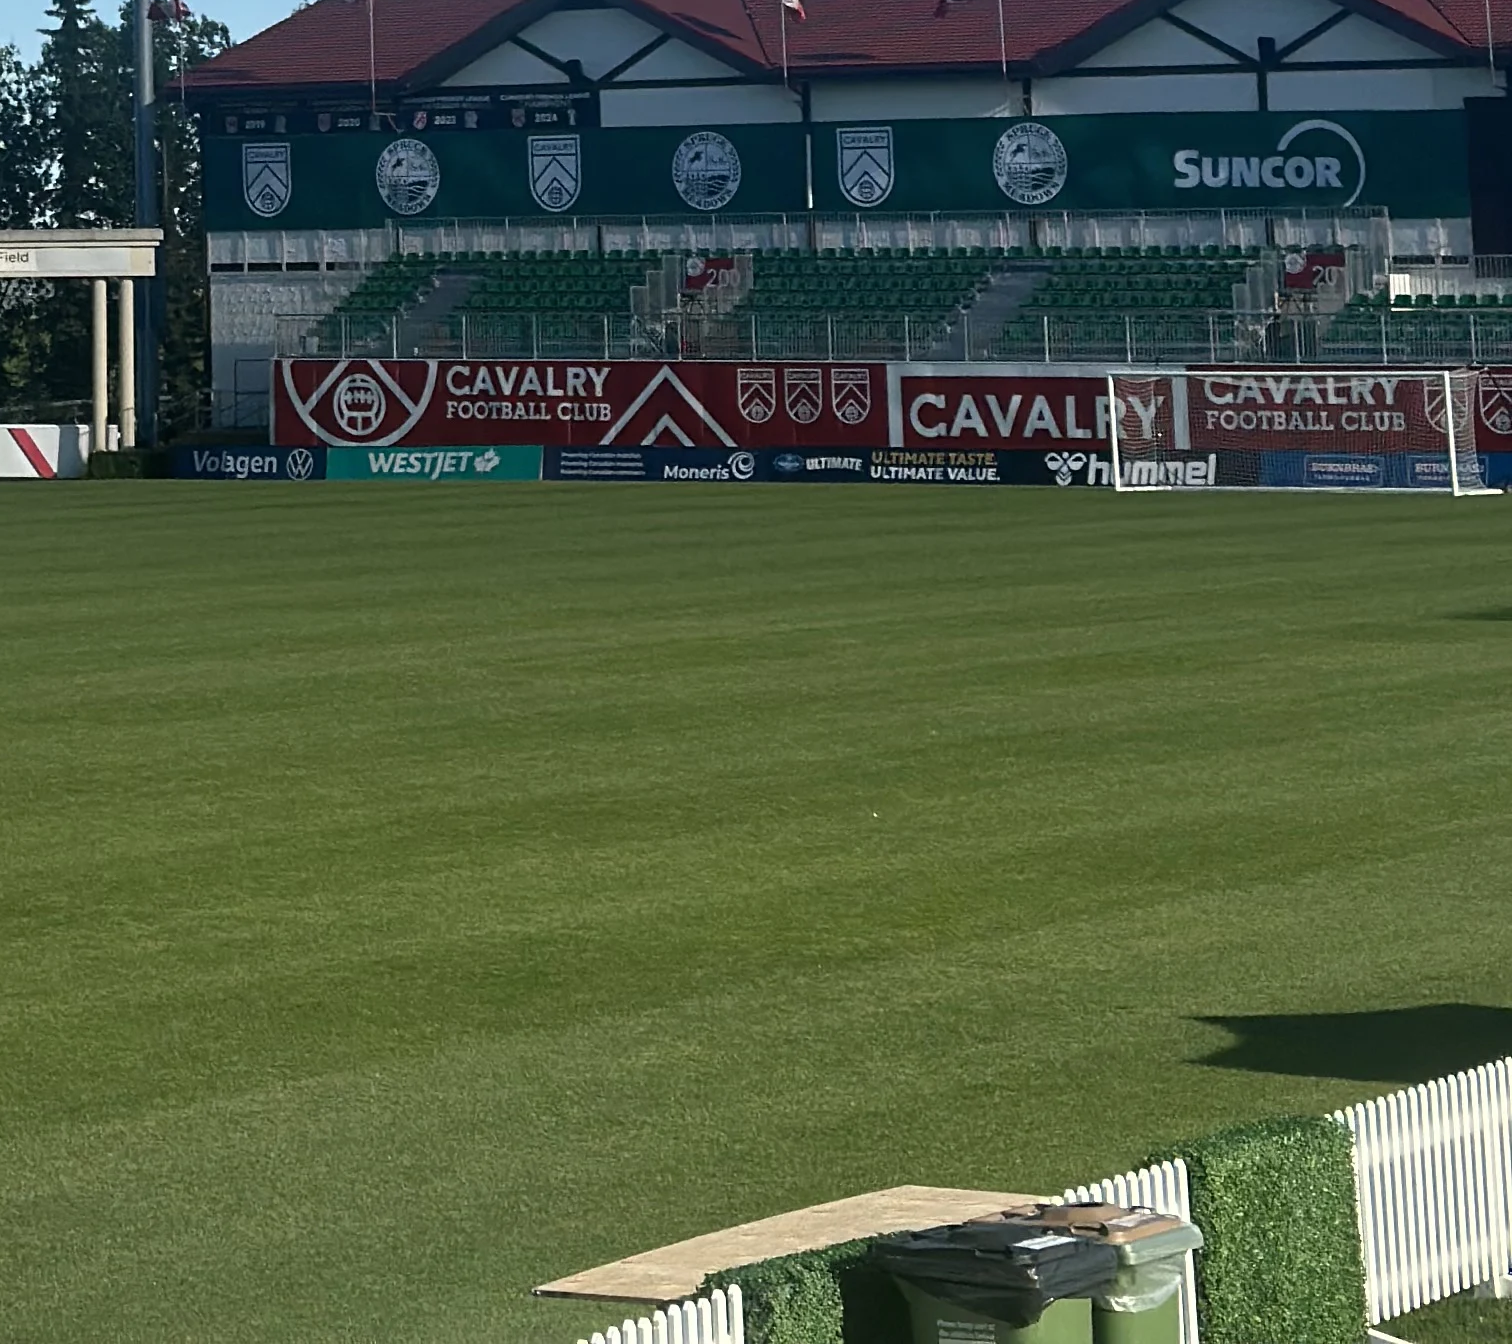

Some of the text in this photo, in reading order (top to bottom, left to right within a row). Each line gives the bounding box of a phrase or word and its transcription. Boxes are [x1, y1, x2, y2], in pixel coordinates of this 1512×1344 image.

[1173, 149, 1344, 188] SUNCOR
[446, 365, 611, 397] CAVALRY
[1204, 376, 1402, 405] CAVALRY
[446, 400, 612, 421] FOOTBALL CLUB
[909, 393, 1165, 440] CAVALRY
[1205, 410, 1405, 432] FOOTBALL CLUB
[368, 451, 473, 480] WESTJET
[806, 457, 862, 471] ULTIMATE
[871, 451, 998, 466] ULTIMATE TASTE.
[663, 465, 730, 480] Moneris
[870, 465, 1001, 481] ULTIMATE VALUE.
